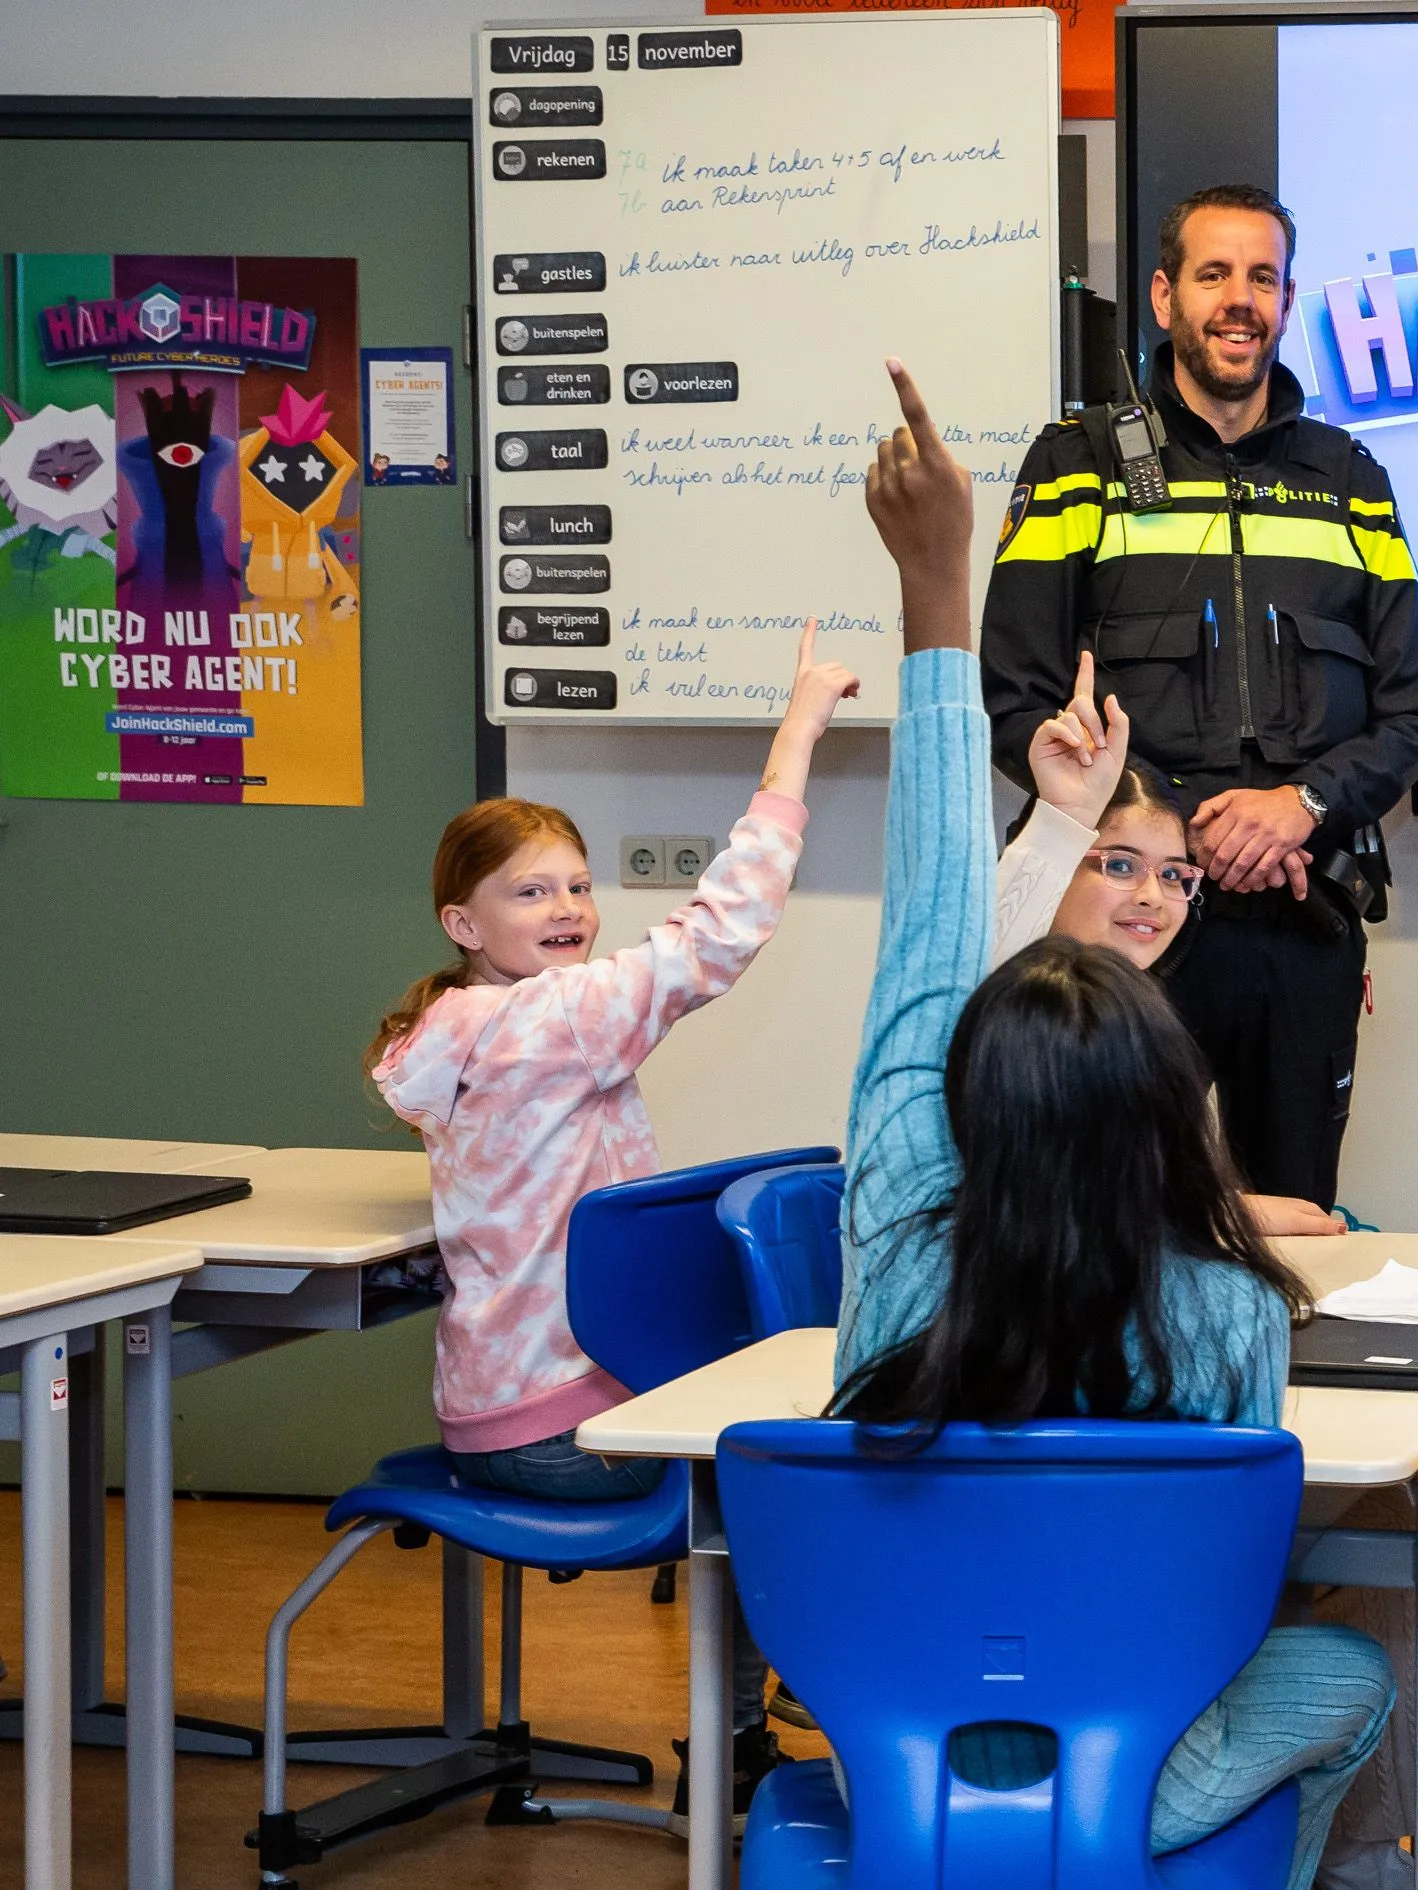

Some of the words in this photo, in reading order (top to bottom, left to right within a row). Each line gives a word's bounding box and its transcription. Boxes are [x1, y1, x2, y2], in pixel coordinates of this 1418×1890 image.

[508, 44, 576, 67] Vrijdag
[608, 45, 629, 63] 15
[645, 40, 736, 60] november
[529, 99, 596, 114] dagopening
[537, 153, 595, 167] rekenen
[661, 152, 687, 183] ik
[693, 151, 759, 180] maak
[768, 148, 824, 174] taken
[832, 150, 873, 168] 4+5
[879, 145, 907, 183] af
[911, 152, 937, 166] en
[942, 138, 1006, 163] werk
[712, 176, 837, 217] Rekensprint
[619, 252, 641, 277] ik
[645, 250, 721, 273] luister
[730, 253, 783, 268] naar
[792, 240, 855, 278] uitleg
[865, 240, 911, 258] over
[918, 218, 1042, 256] Hackshield
[541, 266, 593, 285] gastles
[45, 301, 146, 351] HACK
[179, 295, 309, 353] SHIELD
[533, 326, 605, 341] buitenspelen
[111, 351, 153, 364] FUTURE
[546, 373, 574, 383] eten
[577, 374, 591, 383] en
[664, 377, 733, 392] voorlezen
[546, 390, 592, 401] drinken
[621, 428, 640, 453] ik
[643, 430, 696, 451] weet
[701, 435, 794, 450] wanneer
[803, 422, 823, 446] ik
[828, 435, 860, 446] een
[979, 426, 1031, 445] moet
[551, 443, 583, 459] taal
[622, 462, 713, 496] schrijven
[721, 464, 748, 485] als
[750, 461, 783, 486] het
[787, 465, 825, 485] met
[970, 461, 1017, 483] make
[550, 517, 594, 534] lunch
[536, 566, 607, 580] buitenspelen
[54, 608, 146, 645] WORD
[164, 610, 211, 646] NU
[229, 612, 303, 649] OOK
[537, 612, 599, 628] begrijpend
[622, 607, 641, 630] ik
[649, 607, 698, 629] maak
[737, 611, 885, 634] samenattende
[553, 629, 584, 640] lezen
[625, 642, 648, 662] de
[656, 640, 707, 663] tekst
[60, 652, 173, 690] CYBER
[185, 655, 297, 696] AGENT!
[557, 682, 598, 697] lezen
[629, 668, 650, 696] ik
[707, 684, 739, 697] een
[743, 685, 793, 713] enqu
[112, 717, 248, 734] JoinHackShield.com
[110, 773, 161, 783] DOWNLOAD
[175, 774, 197, 783] APP!
